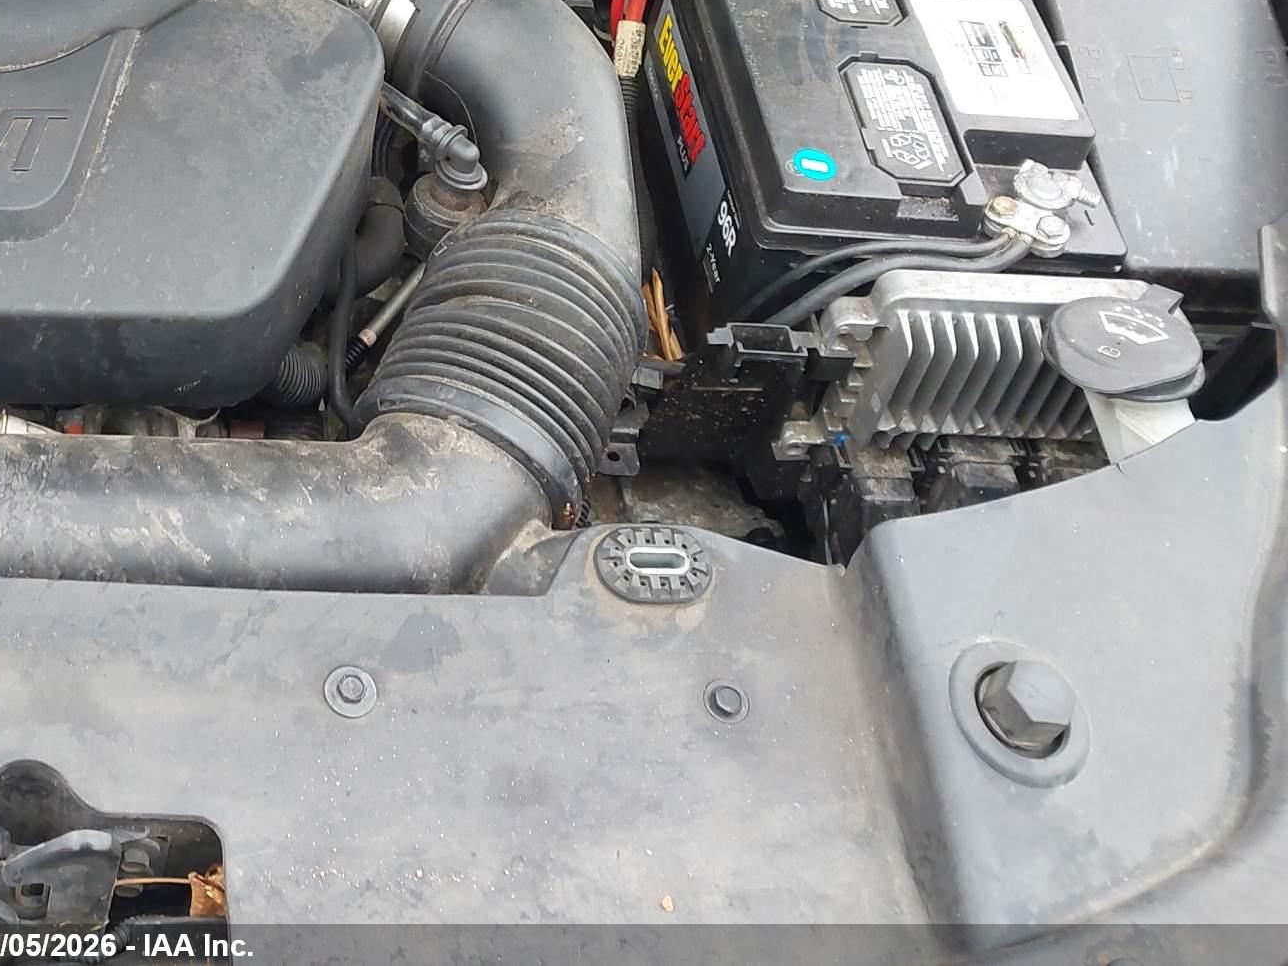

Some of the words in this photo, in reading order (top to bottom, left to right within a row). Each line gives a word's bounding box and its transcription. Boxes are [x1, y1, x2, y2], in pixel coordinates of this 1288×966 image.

[658, 13, 706, 165] EverStart
[677, 135, 689, 171] PLUS
[717, 201, 736, 258] 96R
